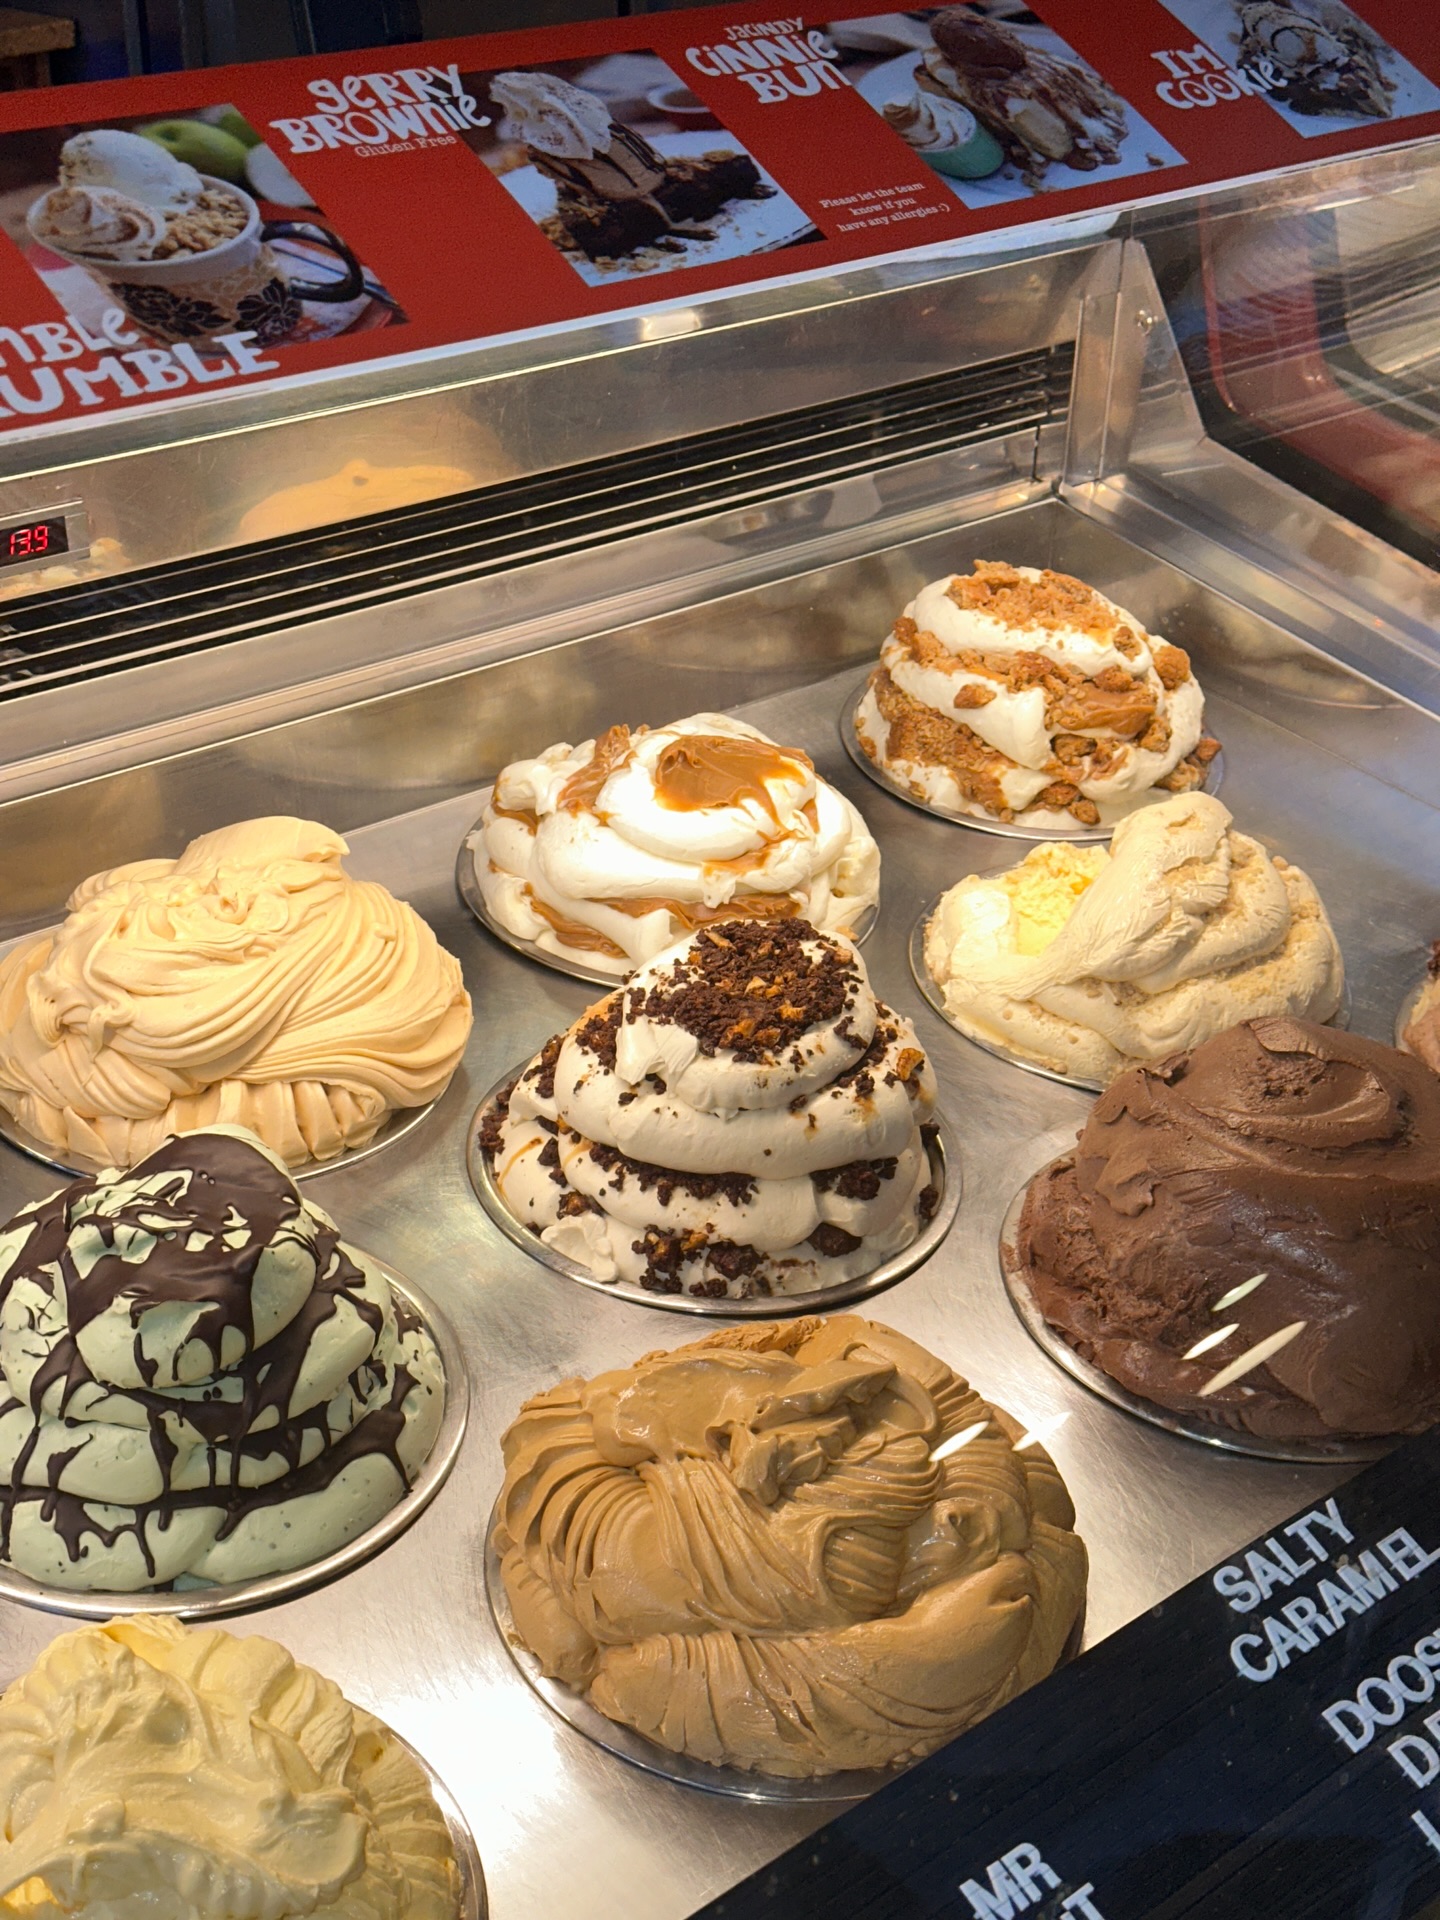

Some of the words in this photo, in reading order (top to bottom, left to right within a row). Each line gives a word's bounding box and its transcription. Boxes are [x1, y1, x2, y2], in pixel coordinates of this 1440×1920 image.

[1150, 44, 1226, 79] I'M
[354, 142, 416, 157] Gluten
[414, 135, 457, 149] Free
[819, 196, 858, 208] Please
[858, 191, 876, 201] let
[874, 187, 896, 198] the
[895, 182, 926, 193] team
[849, 203, 883, 216] know
[881, 199, 895, 209] if
[894, 197, 917, 209] you
[836, 221, 868, 232] have
[868, 215, 890, 226] any
[890, 204, 939, 222] allergies
[0, 331, 280, 418] UMBLE
[9, 524, 49, 557] 13.9
[1213, 1497, 1356, 1614] SALTY
[1230, 1526, 1440, 1683] CARAMEL
[1321, 1628, 1440, 1754] DOOS
[958, 1842, 1063, 1920] MR
